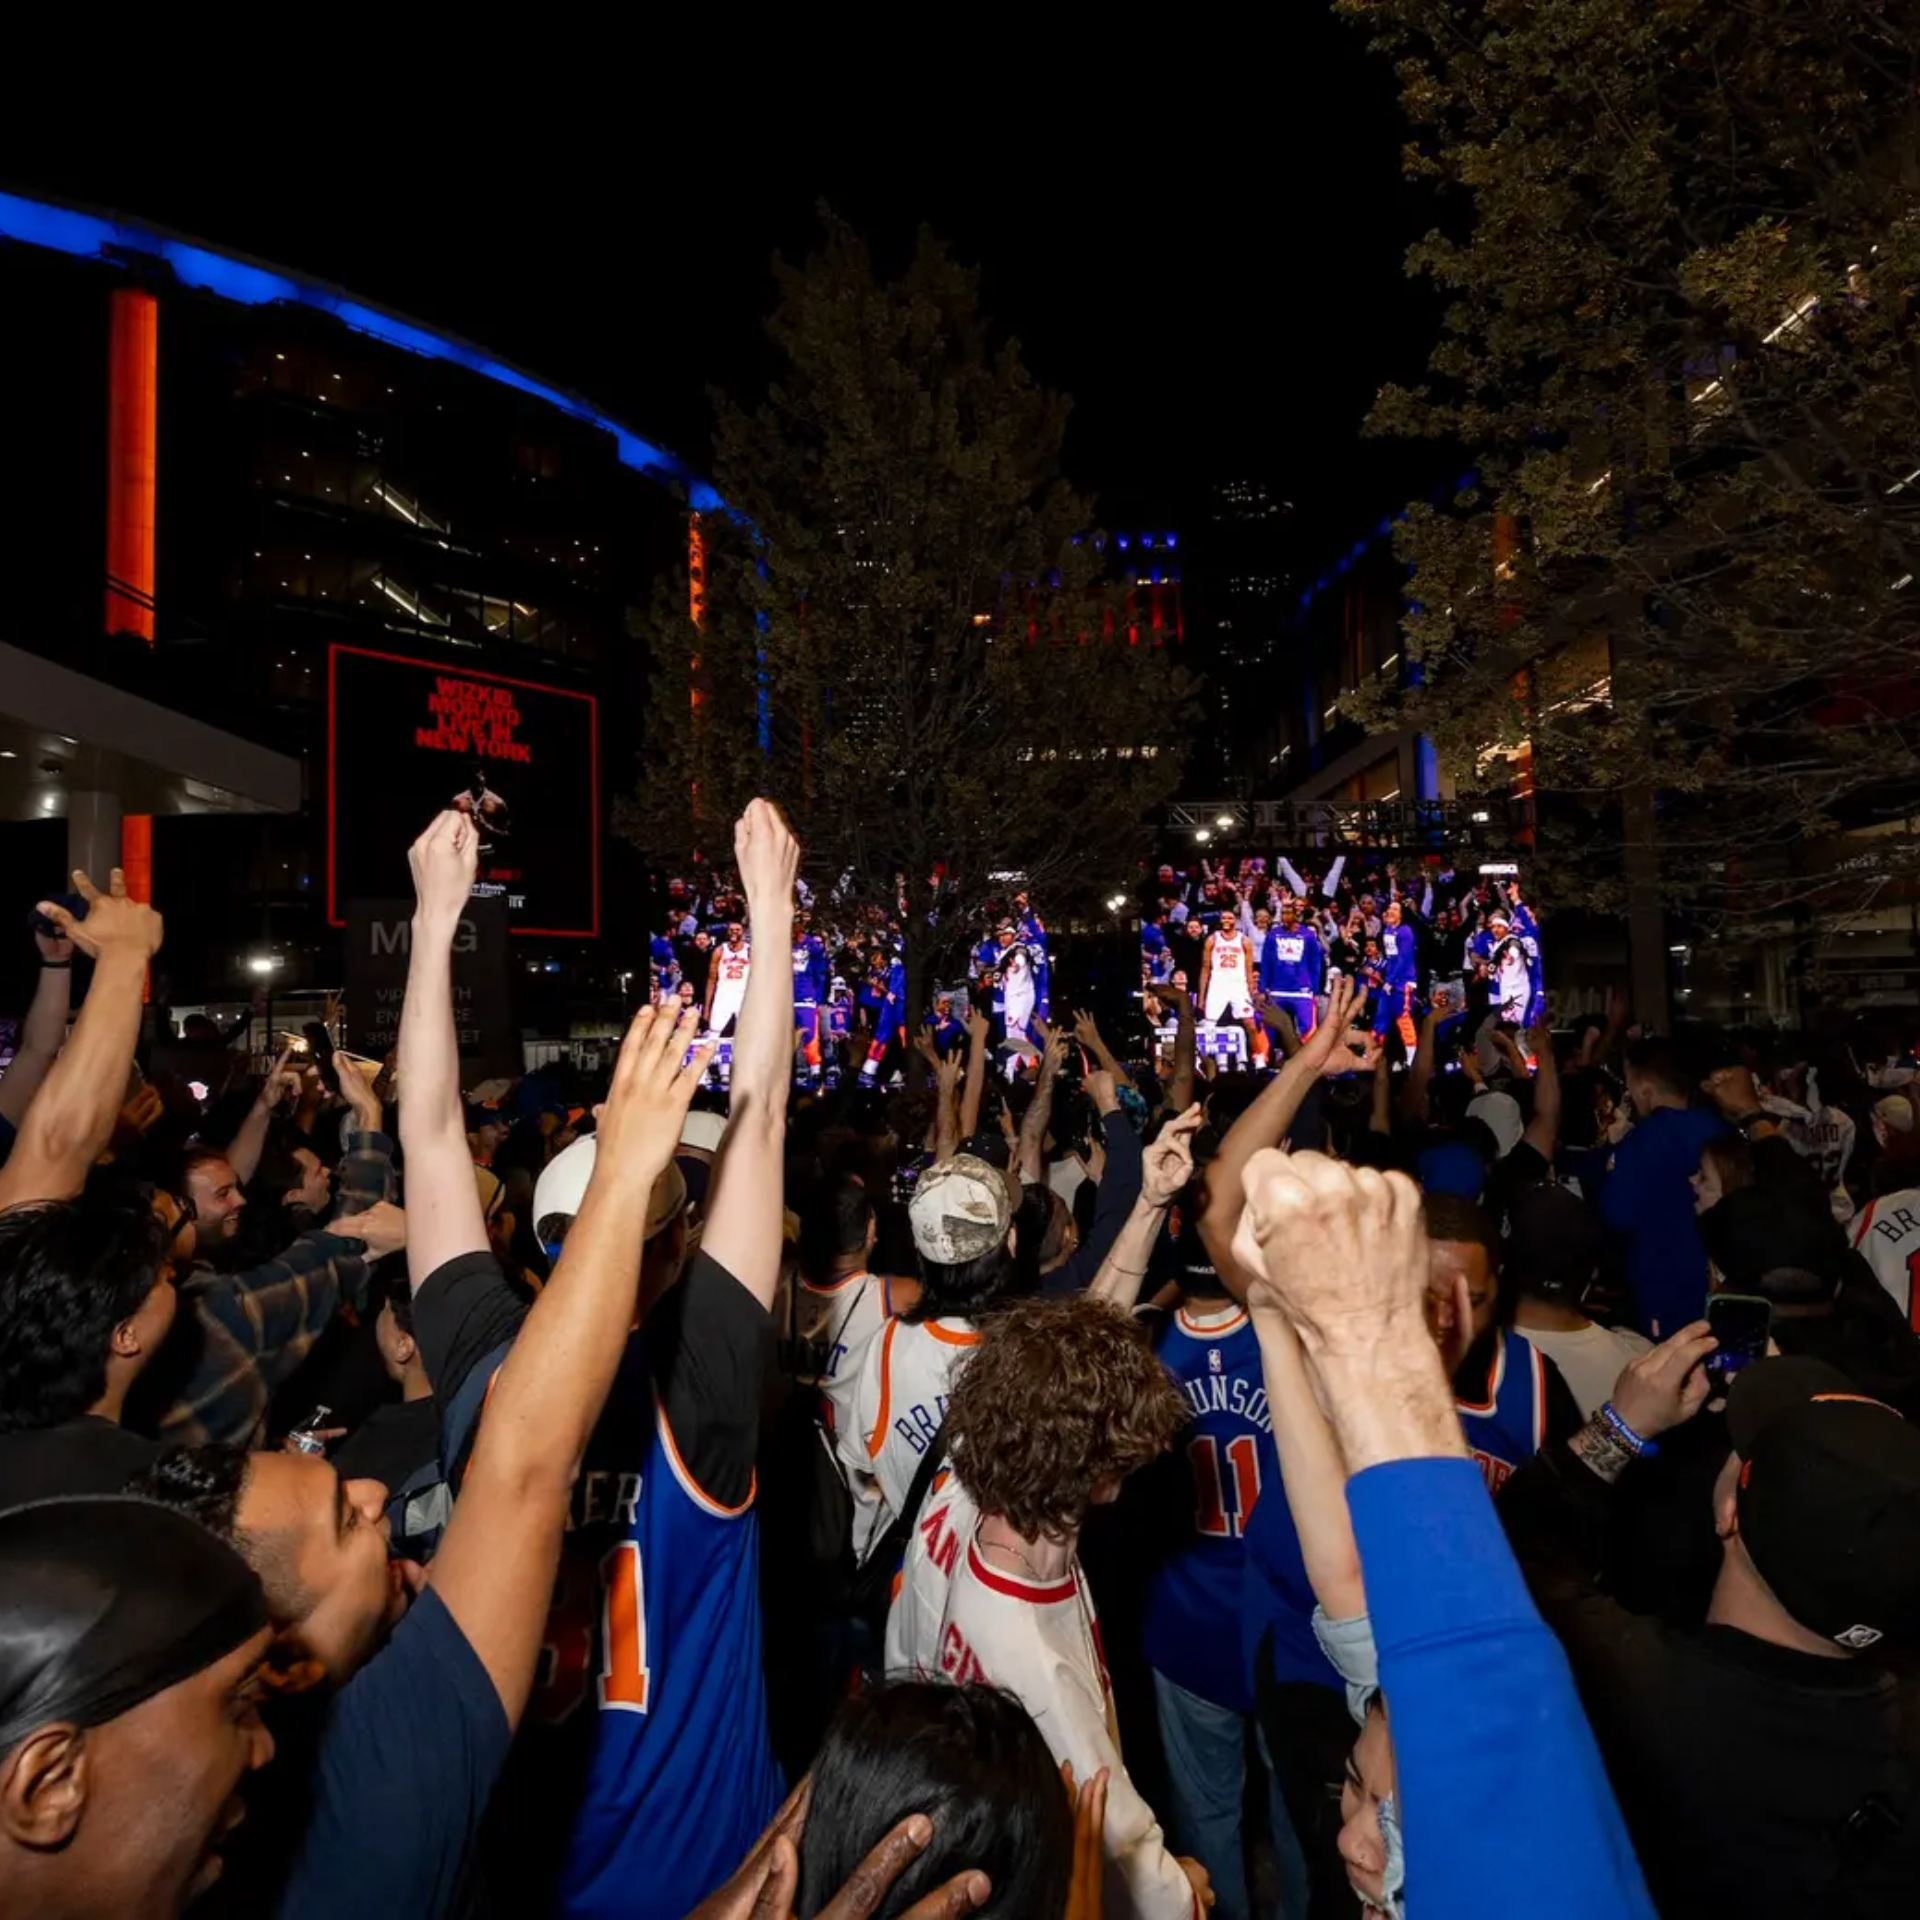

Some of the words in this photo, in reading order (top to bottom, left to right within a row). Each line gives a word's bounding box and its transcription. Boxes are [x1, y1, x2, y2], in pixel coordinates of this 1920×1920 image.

[436, 677, 512, 706] WIZKID
[437, 711, 484, 739] LIVE
[490, 722, 511, 743] IN
[415, 727, 469, 752] NEW
[474, 738, 531, 763] YORK
[370, 919, 478, 955] MG
[726, 965, 743, 979] 25
[1219, 954, 1238, 968] 25
[1186, 1434, 1262, 1538] 11
